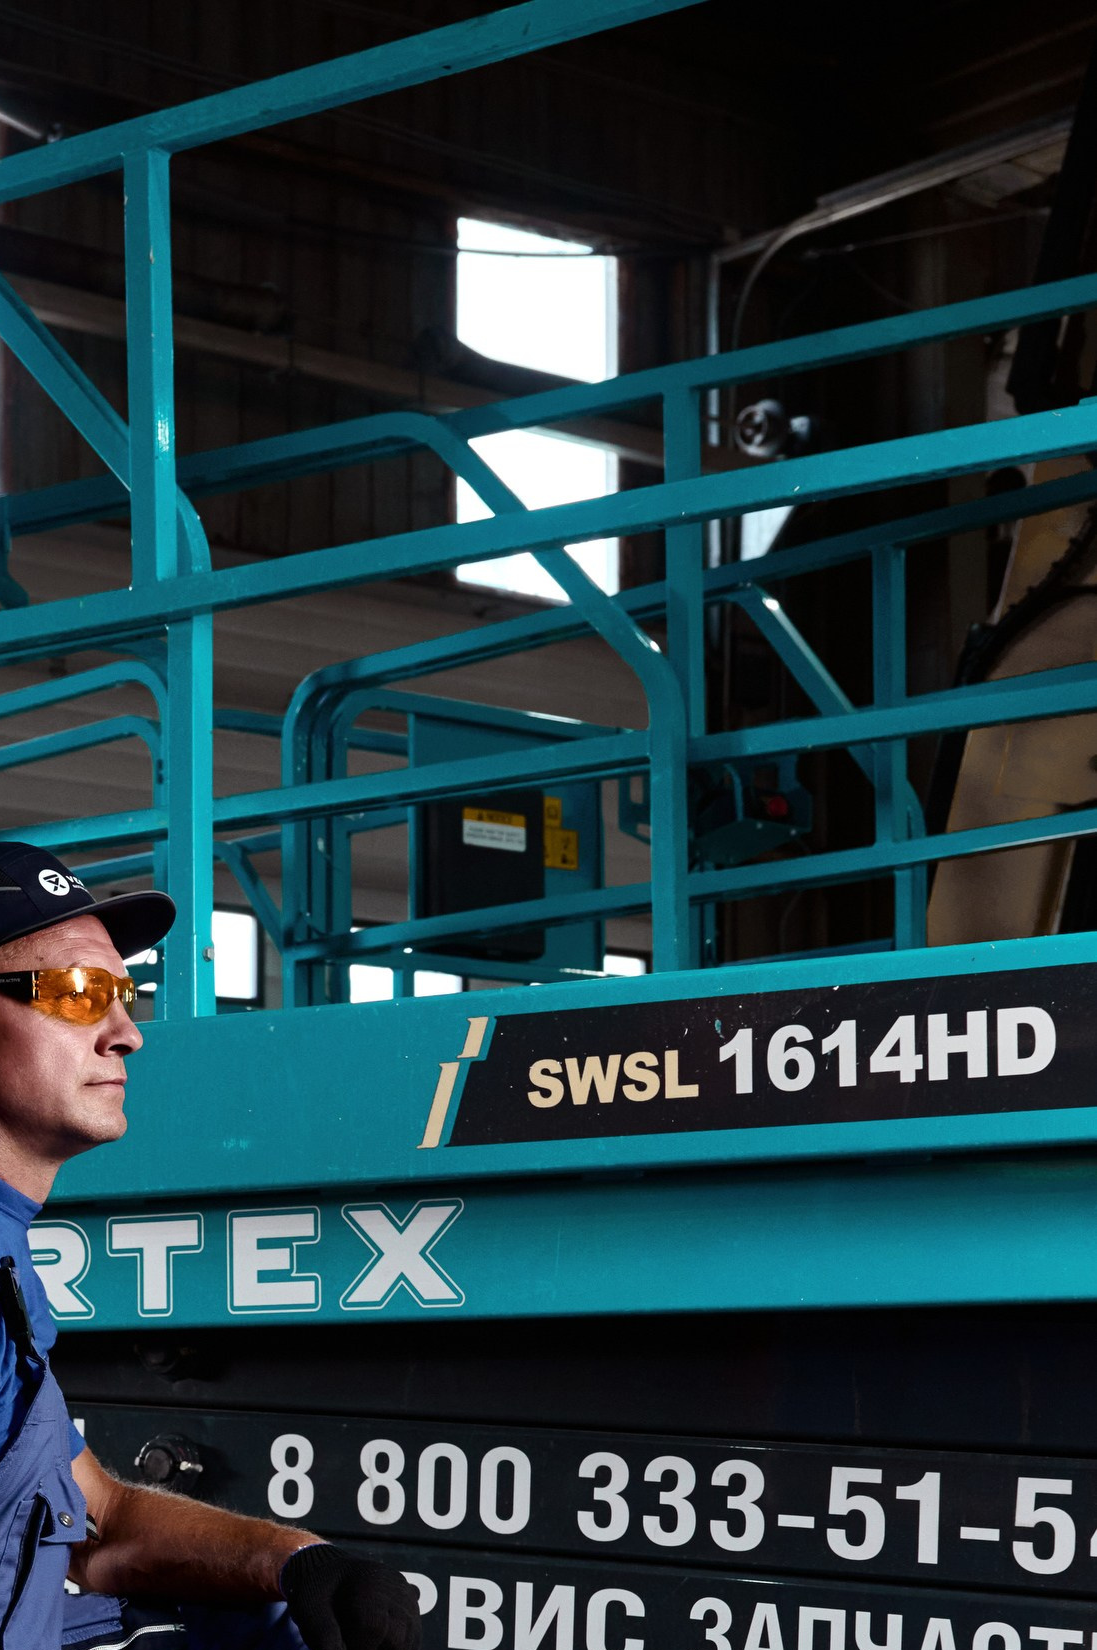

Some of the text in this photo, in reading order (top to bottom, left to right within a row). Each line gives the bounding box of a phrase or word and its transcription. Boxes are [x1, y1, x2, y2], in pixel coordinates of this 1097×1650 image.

[527, 1007, 1057, 1108] SWSL 1614HD
[28, 1198, 466, 1320] RTEX
[267, 1433, 1097, 1575] 8 800 333-51-5
